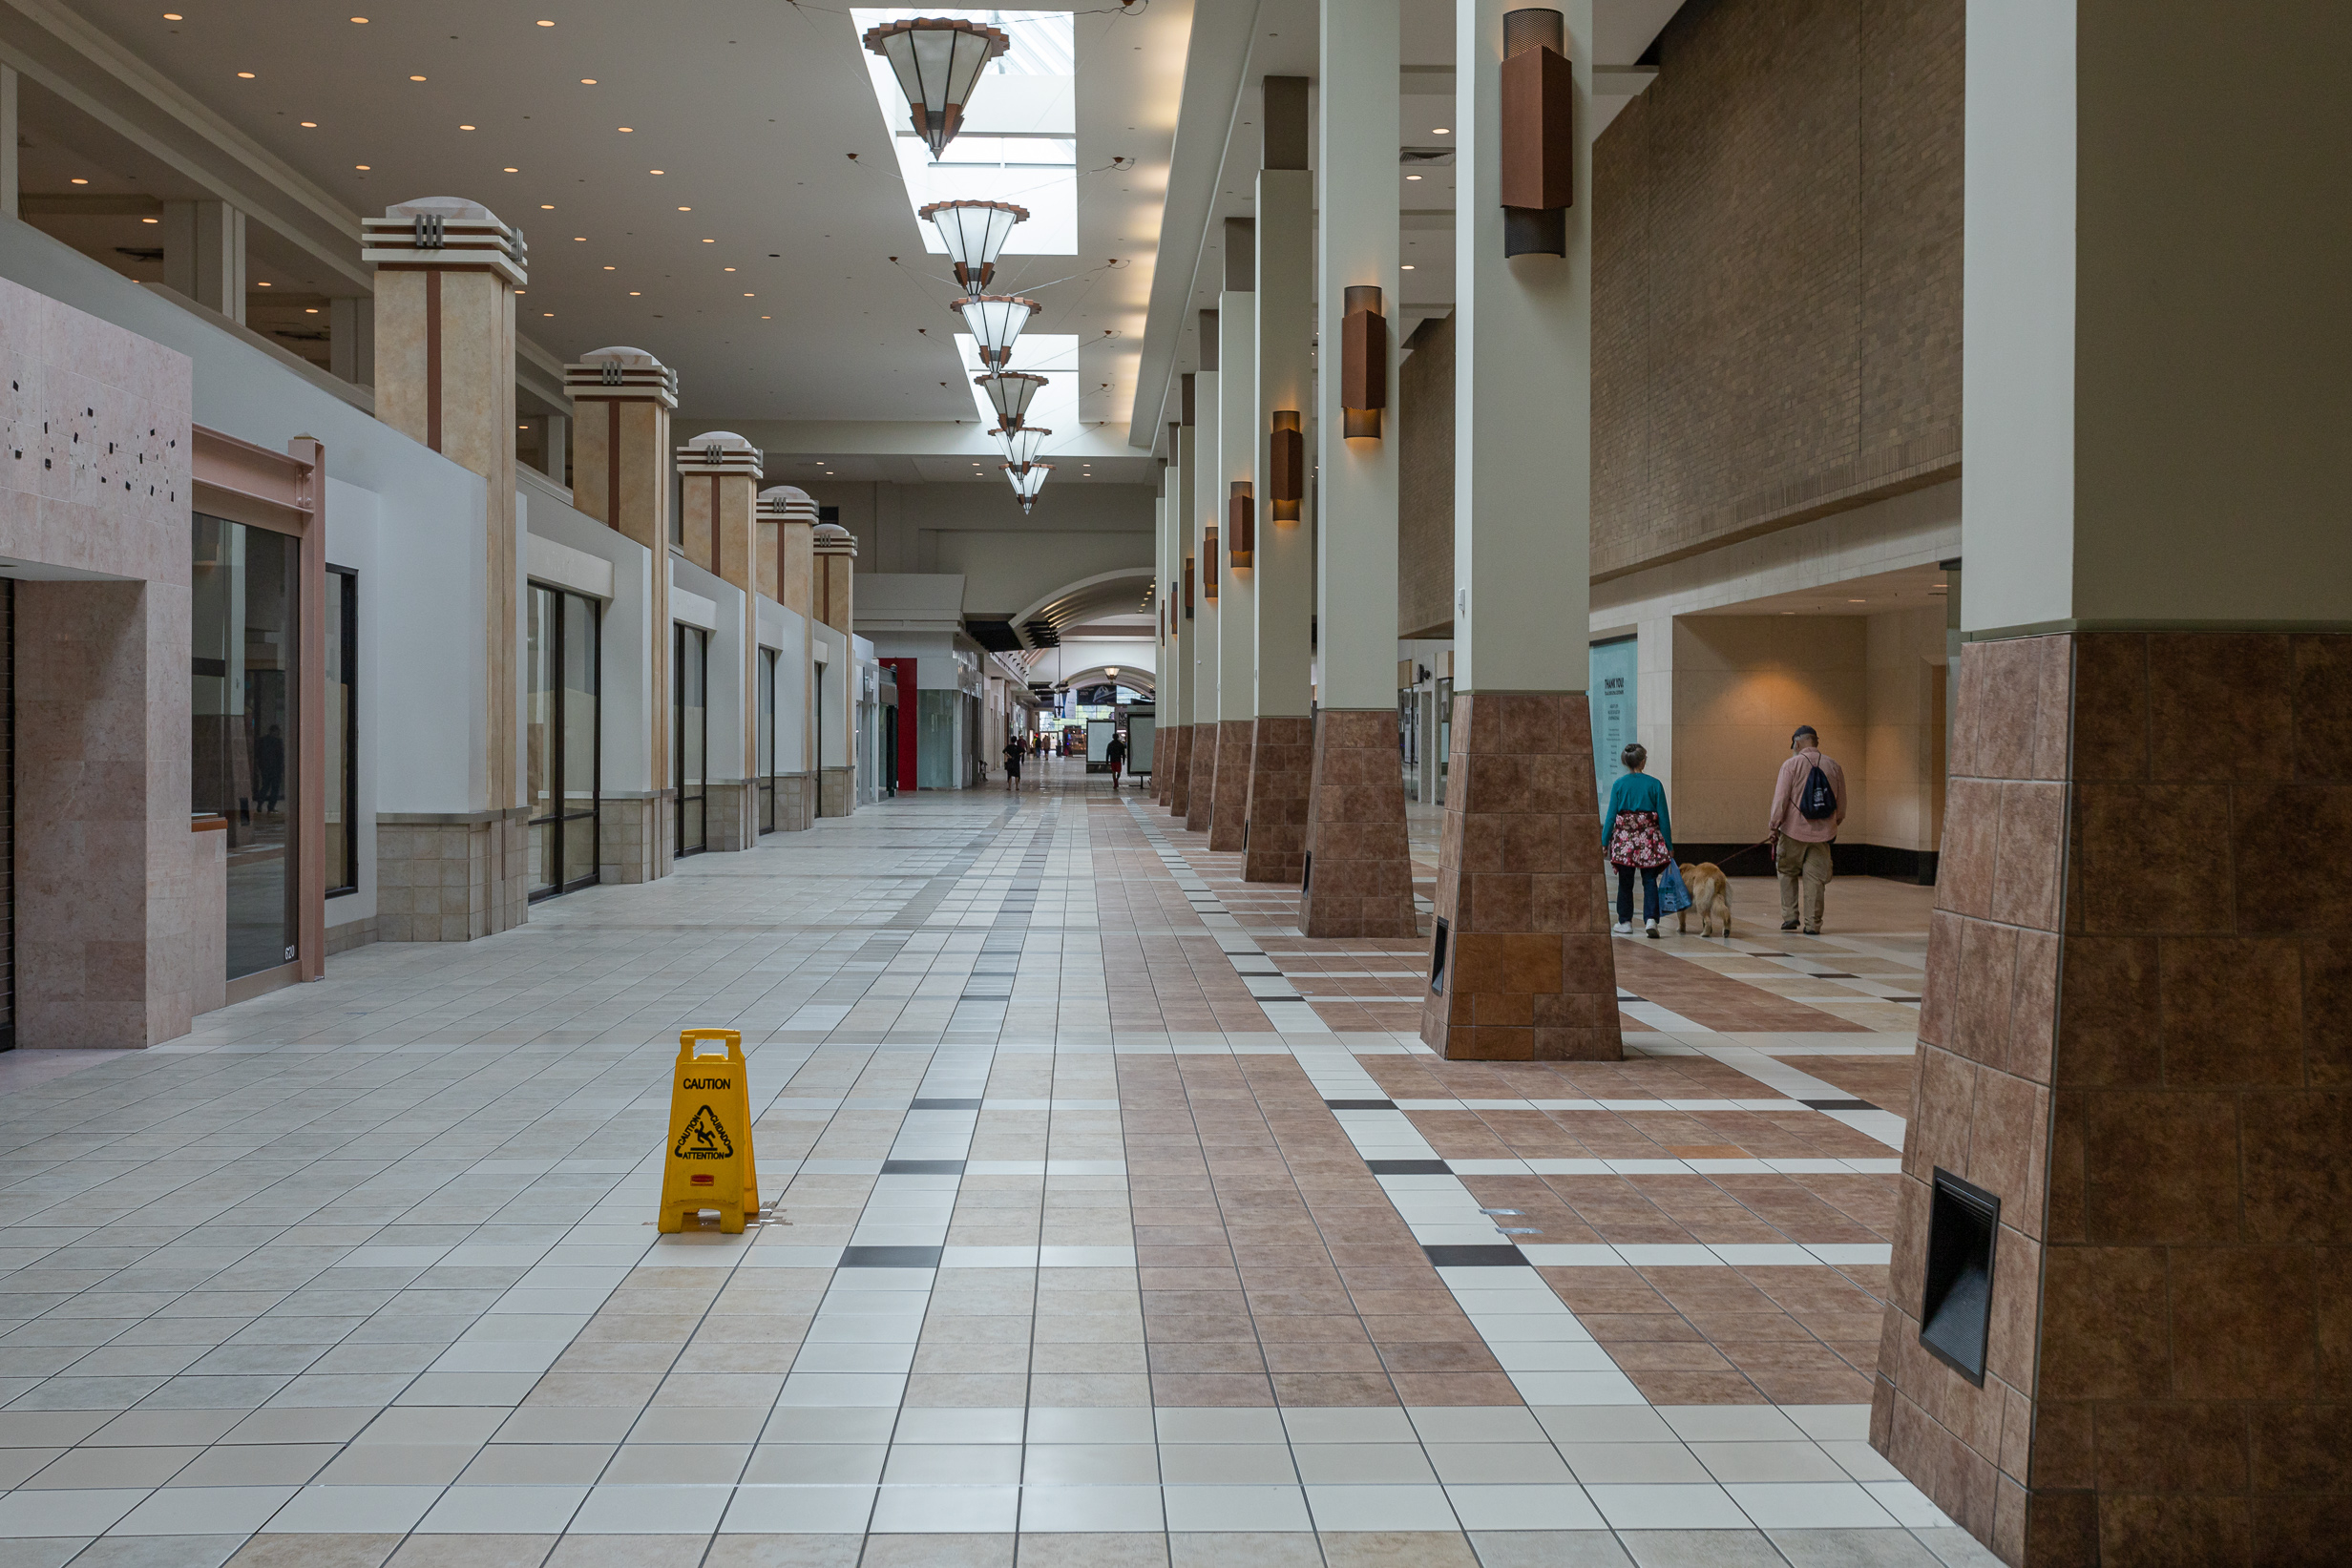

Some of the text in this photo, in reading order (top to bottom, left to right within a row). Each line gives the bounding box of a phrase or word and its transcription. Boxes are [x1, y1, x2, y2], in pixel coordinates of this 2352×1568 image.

[1605, 679, 1615, 689] THANK
[284, 945, 295, 960] 620
[683, 1078, 731, 1090] CAUTION
[678, 1115, 702, 1146] CAUTION
[710, 1115, 731, 1146] CUIDADO
